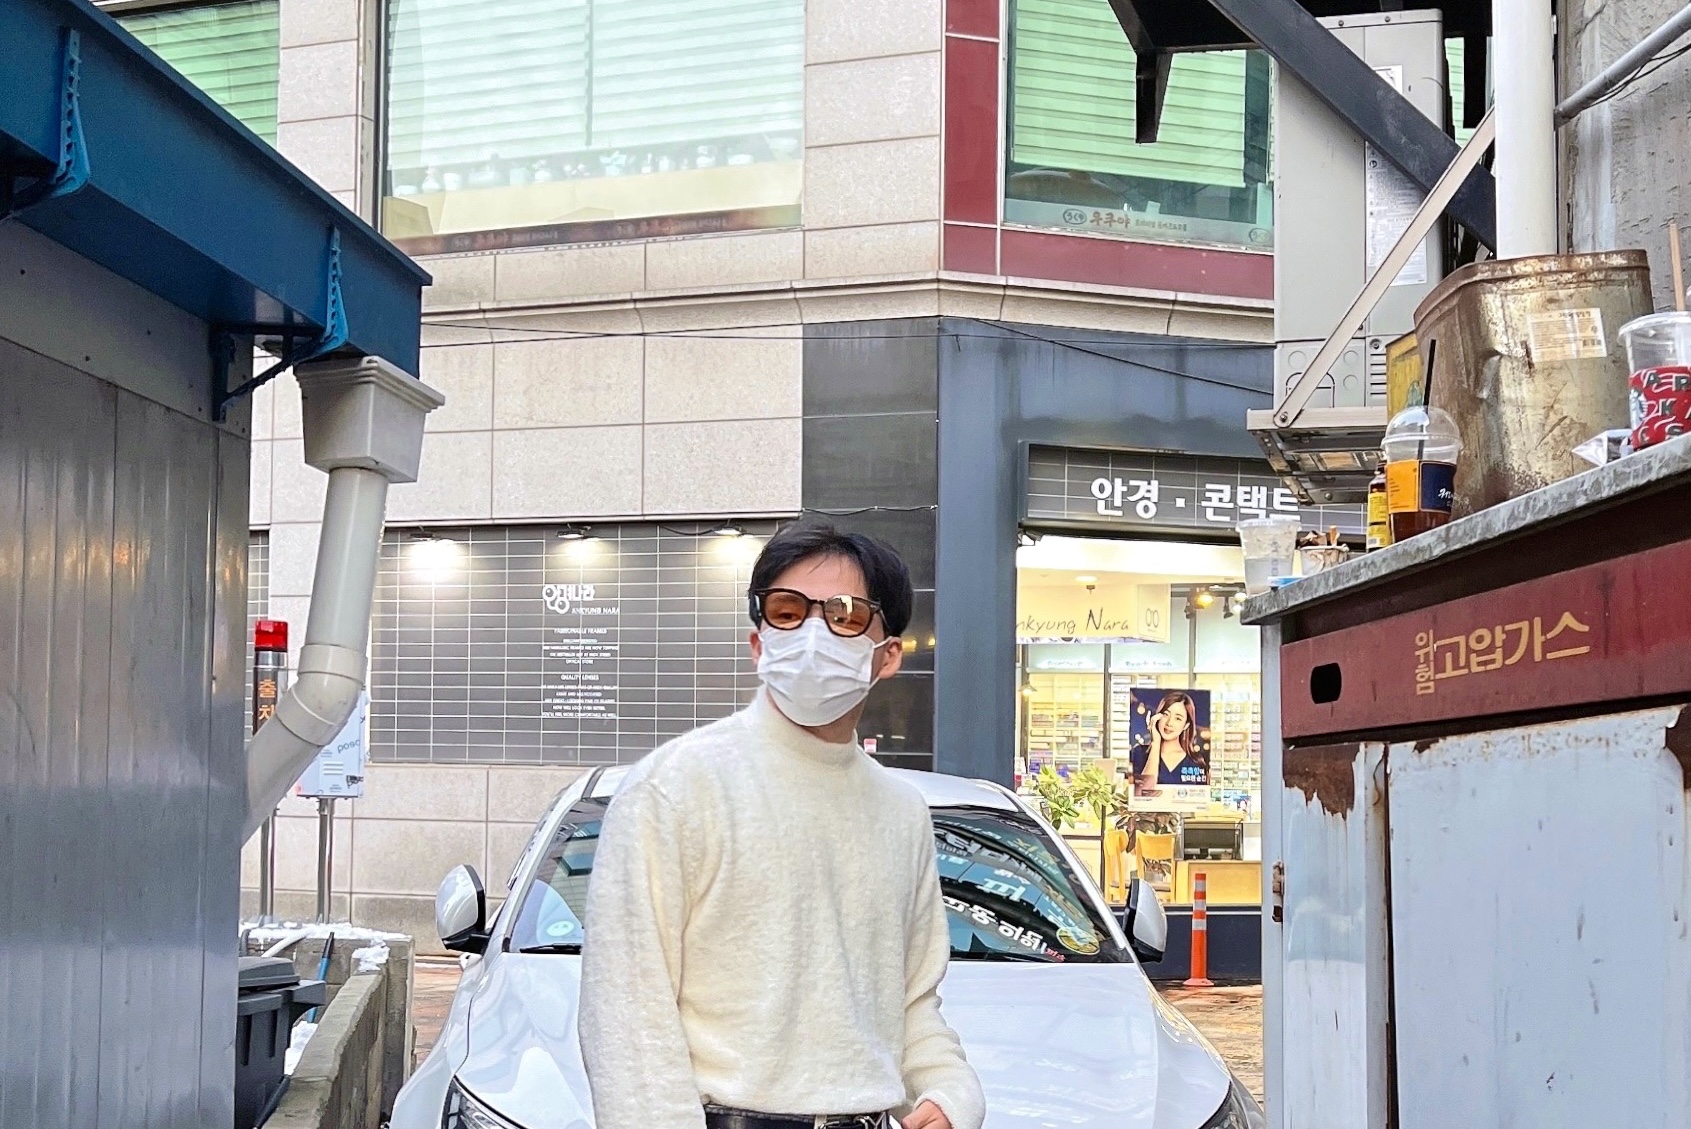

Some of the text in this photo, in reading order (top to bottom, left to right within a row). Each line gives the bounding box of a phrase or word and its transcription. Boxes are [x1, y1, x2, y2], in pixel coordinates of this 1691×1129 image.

[1090, 477, 1300, 522] 안경 콘택트
[1086, 607, 1129, 632] Nara
[1433, 611, 1591, 680] 고압가스
[1415, 629, 1435, 695] 위험
